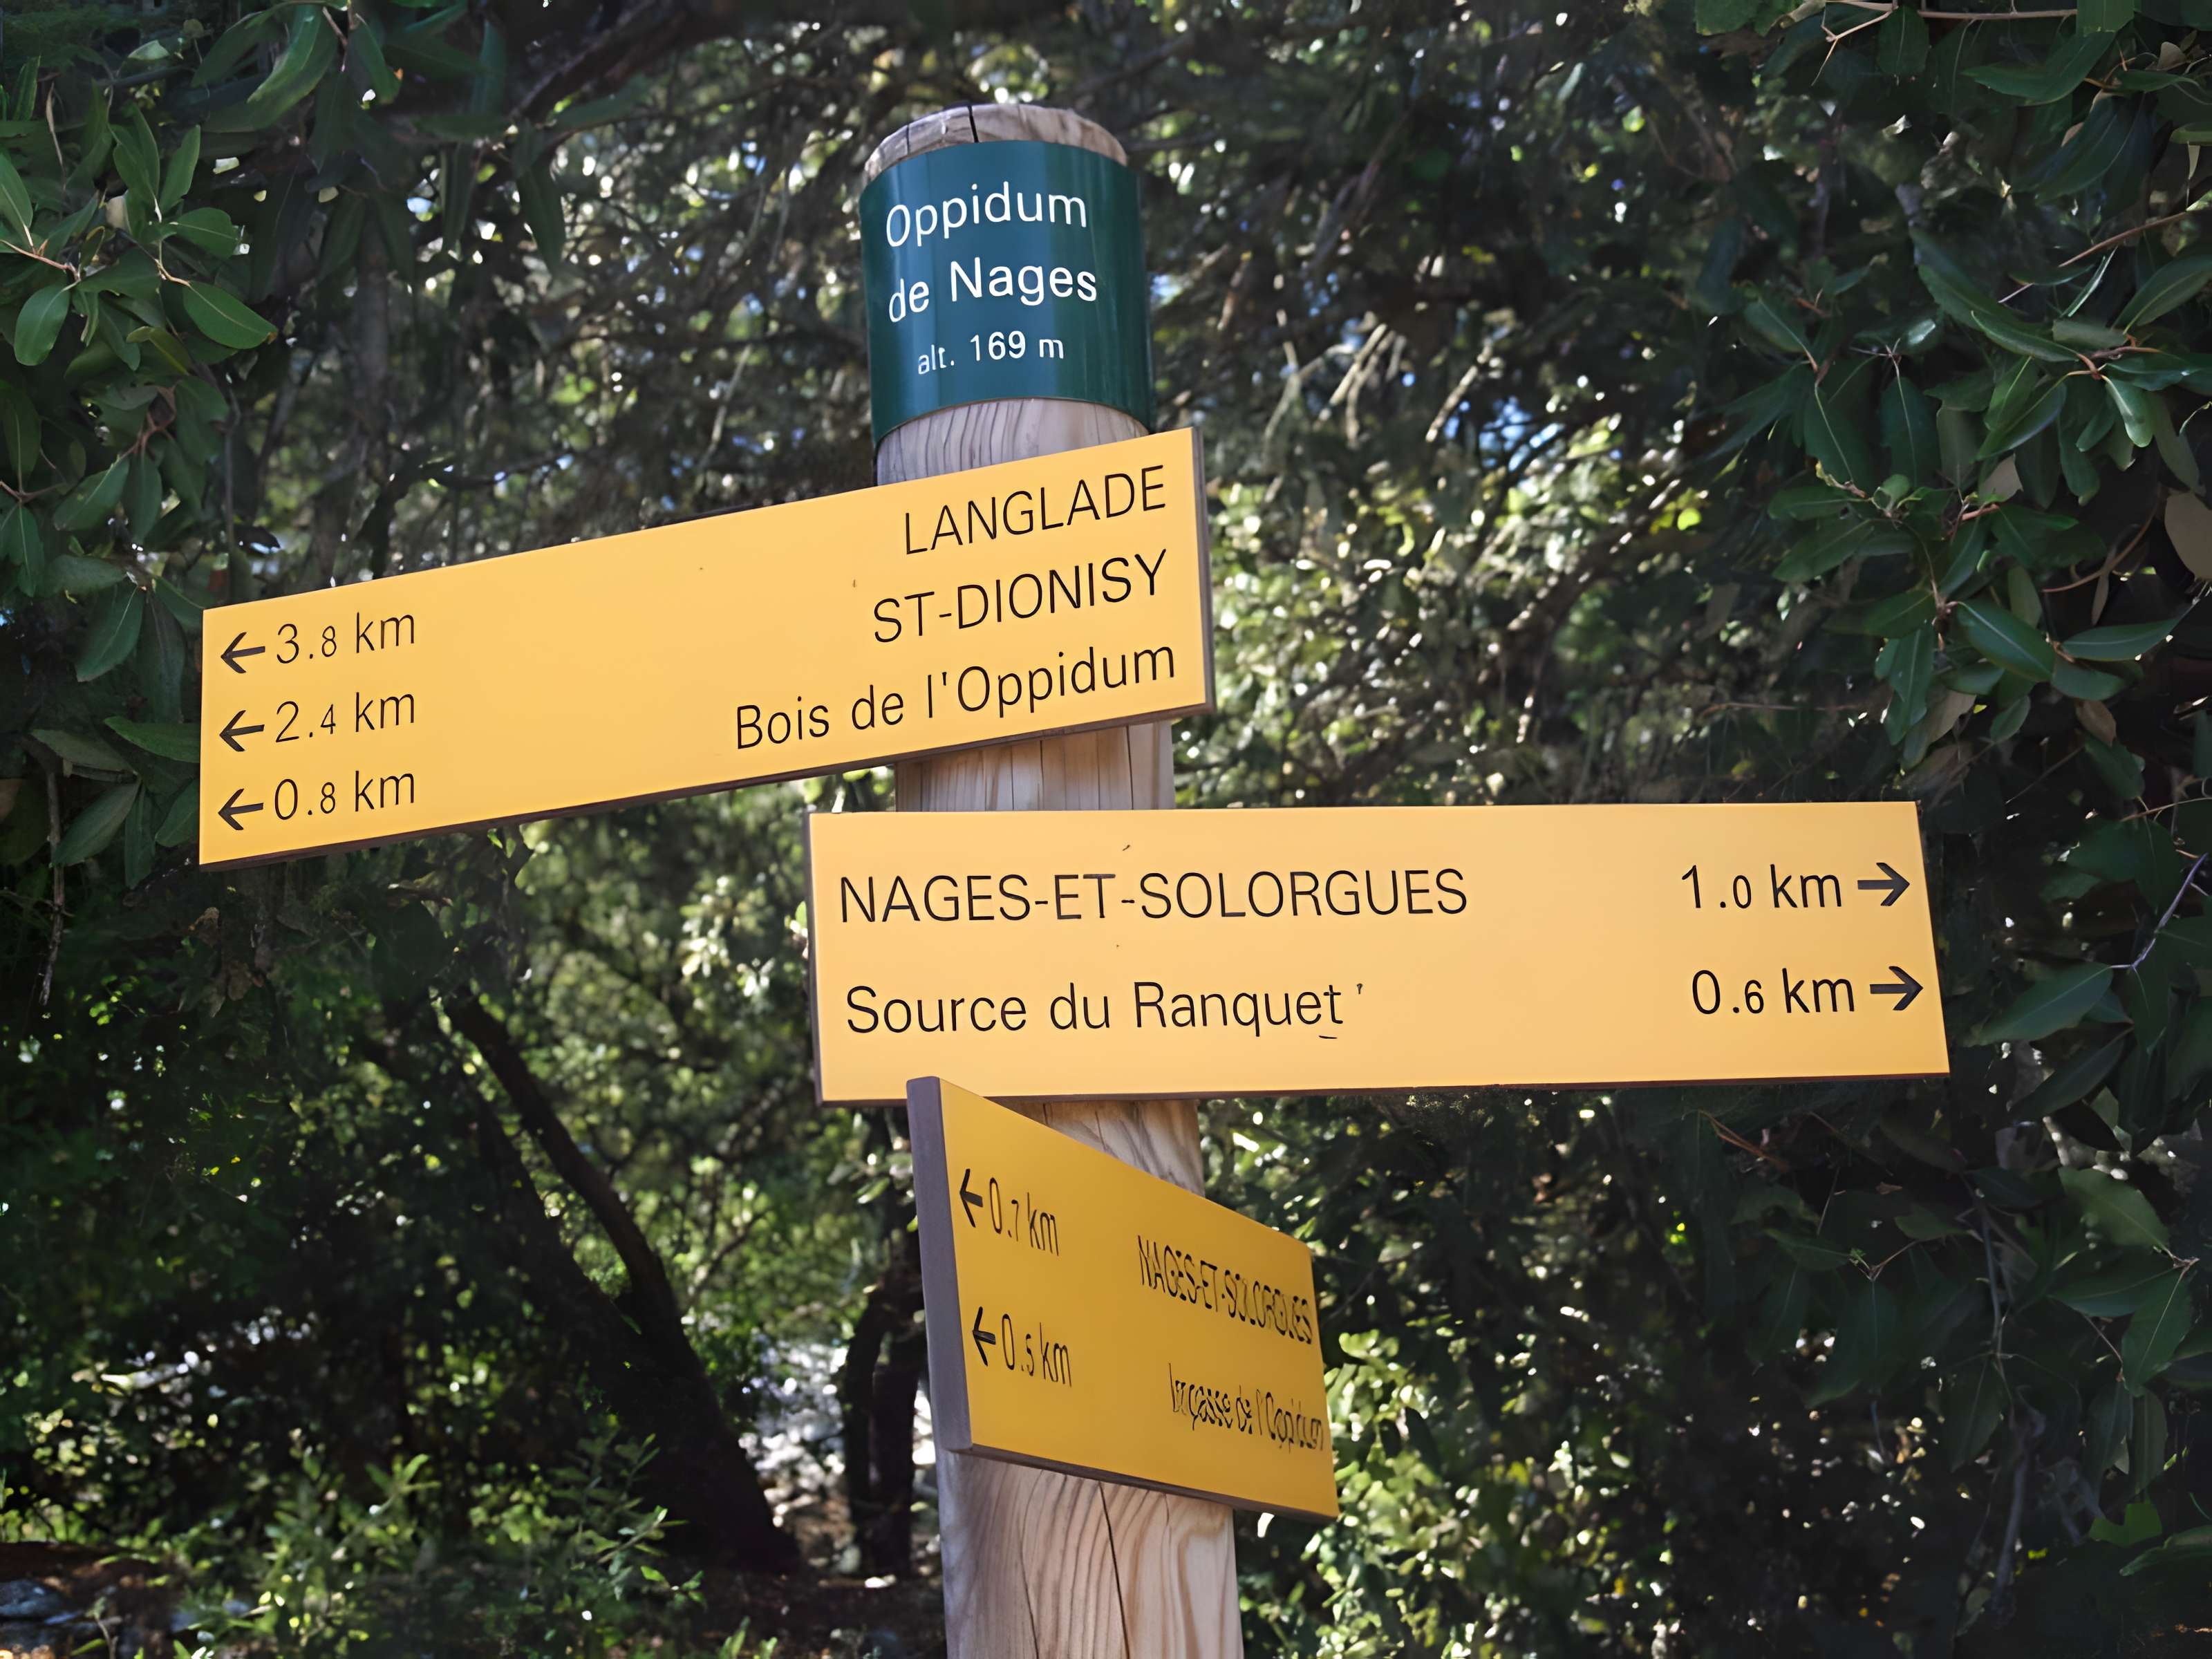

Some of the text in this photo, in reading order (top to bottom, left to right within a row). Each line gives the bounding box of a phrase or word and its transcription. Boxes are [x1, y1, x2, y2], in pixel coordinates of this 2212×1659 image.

[886, 181, 1087, 247] Oppidum
[888, 257, 1097, 322] de Nages
[918, 330, 1065, 375] alt. 169 m
[906, 465, 1166, 555] LANGLADE
[873, 548, 1167, 643] ST-DIONISY
[276, 612, 415, 664] 3.8 km
[276, 692, 415, 742] 2.4 km
[737, 646, 1175, 749] Bois de l'Oppidum
[274, 770, 415, 821] 0.8 km
[840, 868, 1468, 923] NAGES-ET-SOLORGUES
[1681, 863, 1842, 909] 1.0 km
[846, 982, 1343, 1037] Source du Ranquet
[1691, 967, 1855, 1014] 0.6 km
[989, 1177, 1060, 1257] 0.7 km
[1001, 1313, 1072, 1388] 0.5 km
